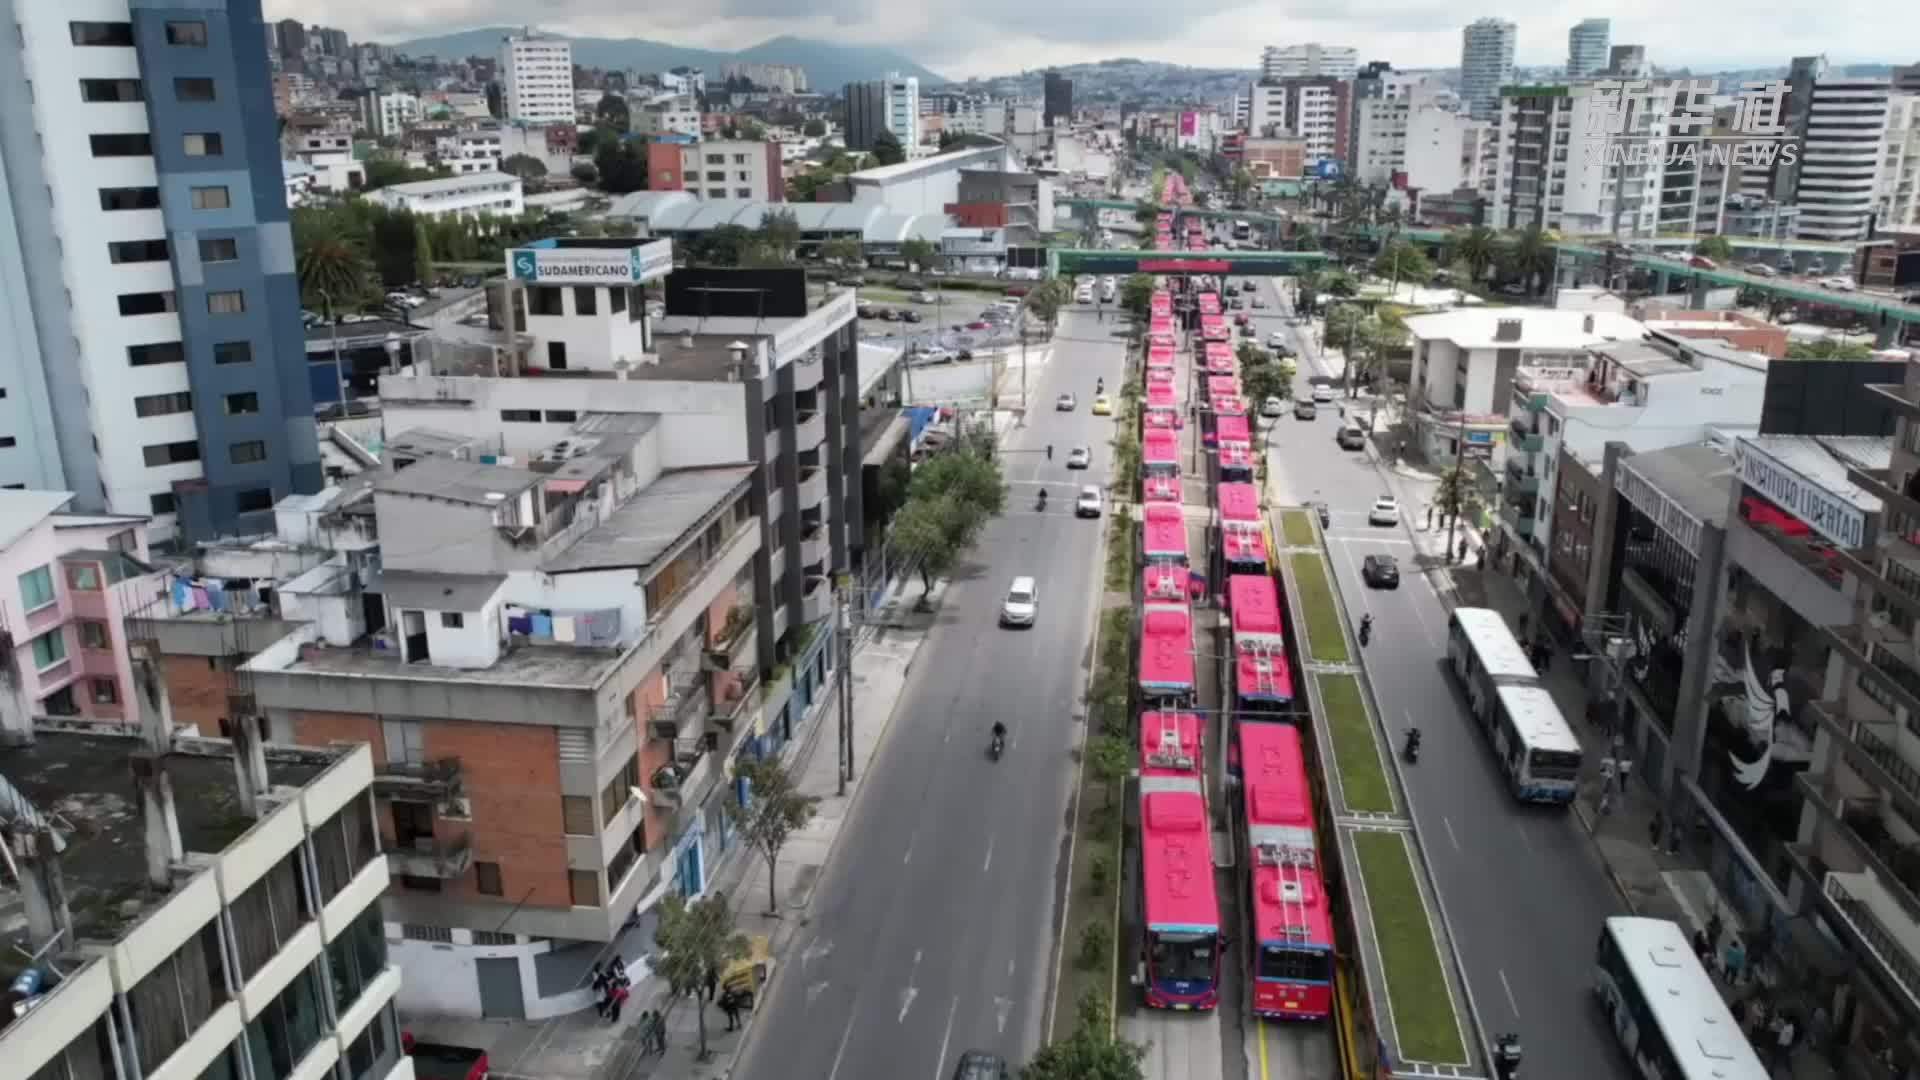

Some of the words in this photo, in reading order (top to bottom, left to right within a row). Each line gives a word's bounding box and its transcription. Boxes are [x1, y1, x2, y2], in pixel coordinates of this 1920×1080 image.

[537, 264, 629, 276] SUDAMERICANO
[1744, 451, 1798, 509] INSTITUTO
[1800, 487, 1860, 546] LIBERTAD
